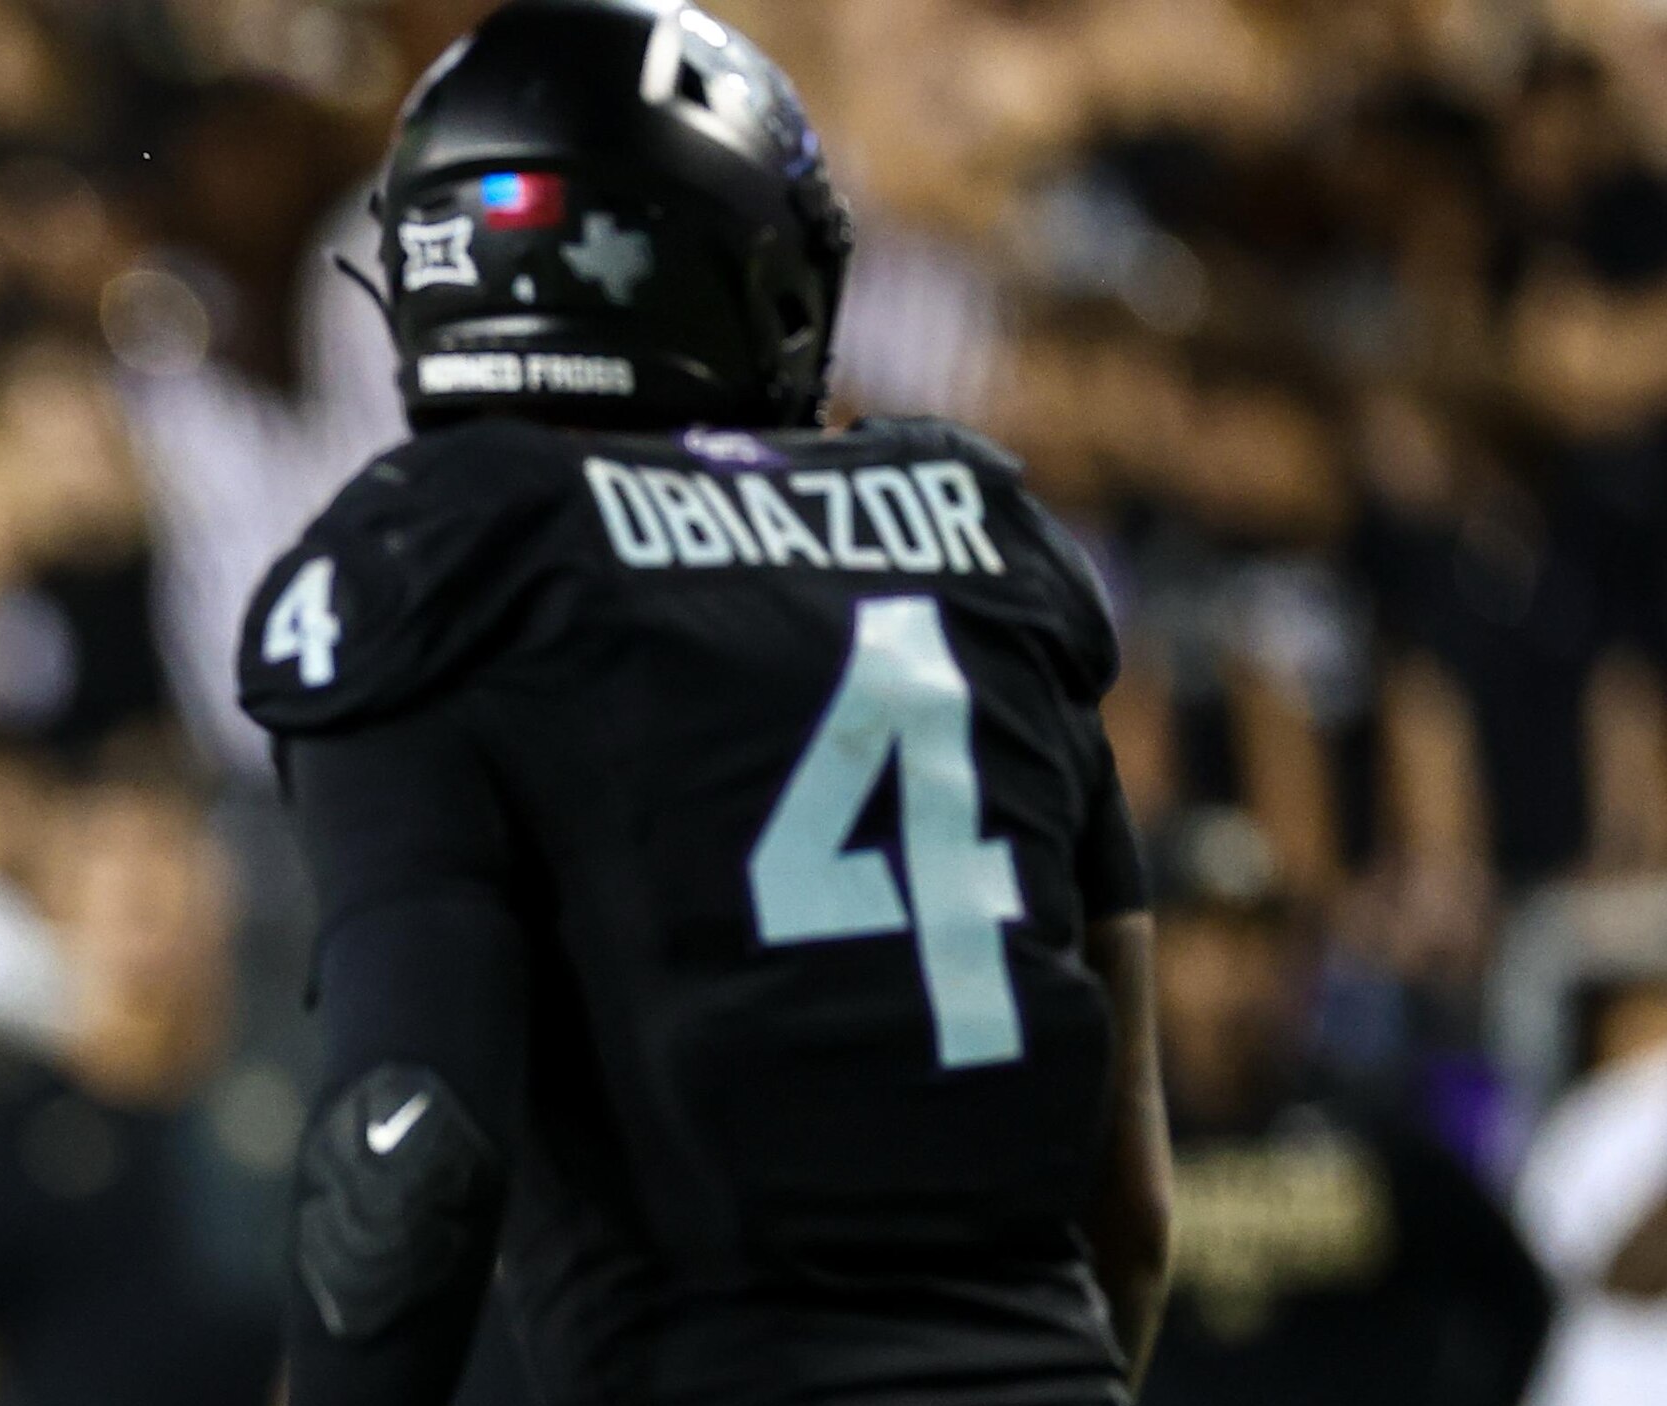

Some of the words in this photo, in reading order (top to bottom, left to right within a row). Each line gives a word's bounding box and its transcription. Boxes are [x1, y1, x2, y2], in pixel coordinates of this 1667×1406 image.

[585, 455, 1005, 576] OBIAZOR
[261, 556, 341, 687] 4
[748, 595, 1025, 1068] 4
